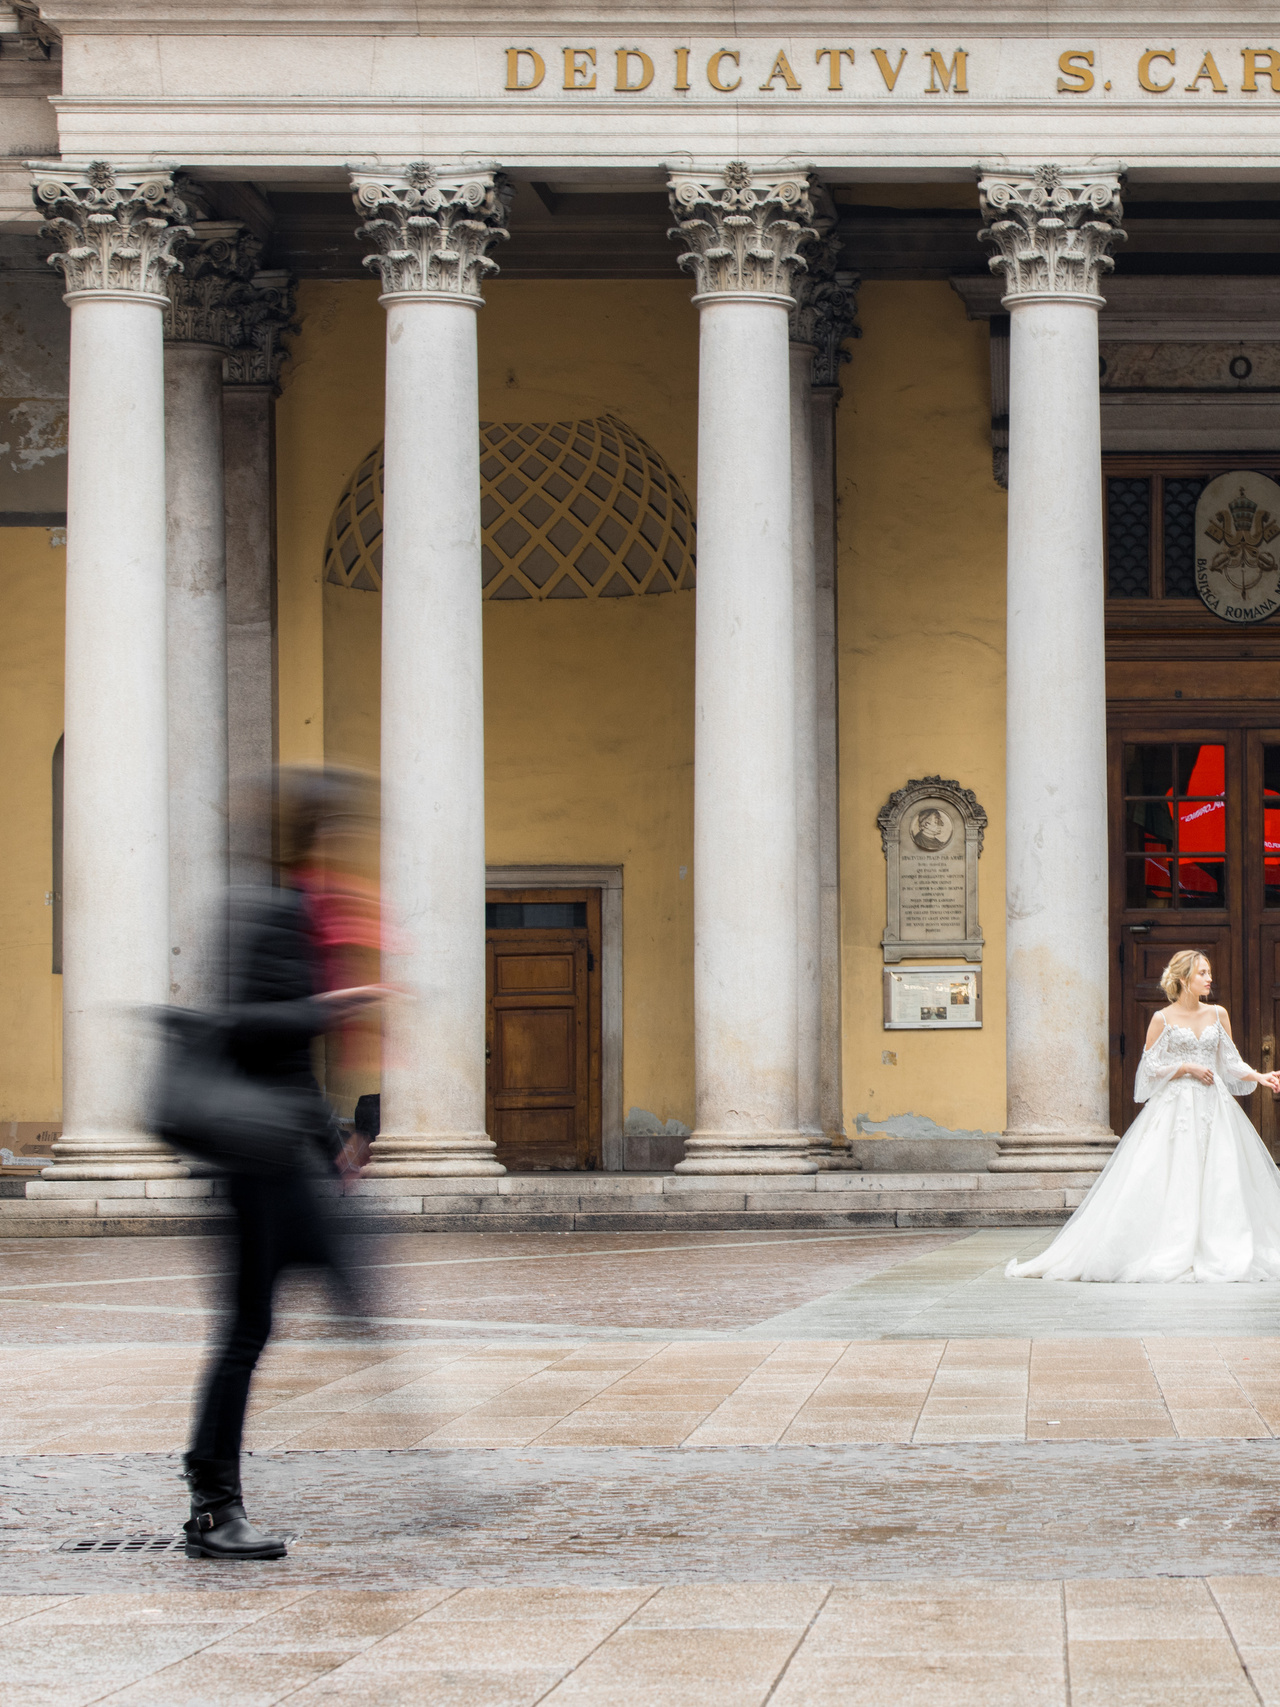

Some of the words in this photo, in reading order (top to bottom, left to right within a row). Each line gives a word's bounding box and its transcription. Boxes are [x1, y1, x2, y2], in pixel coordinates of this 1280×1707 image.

[505, 48, 969, 91] DEDICATVM
[1057, 49, 1113, 92] S.
[1197, 558, 1220, 610] BASILICA
[1225, 598, 1277, 619] ROMANA
